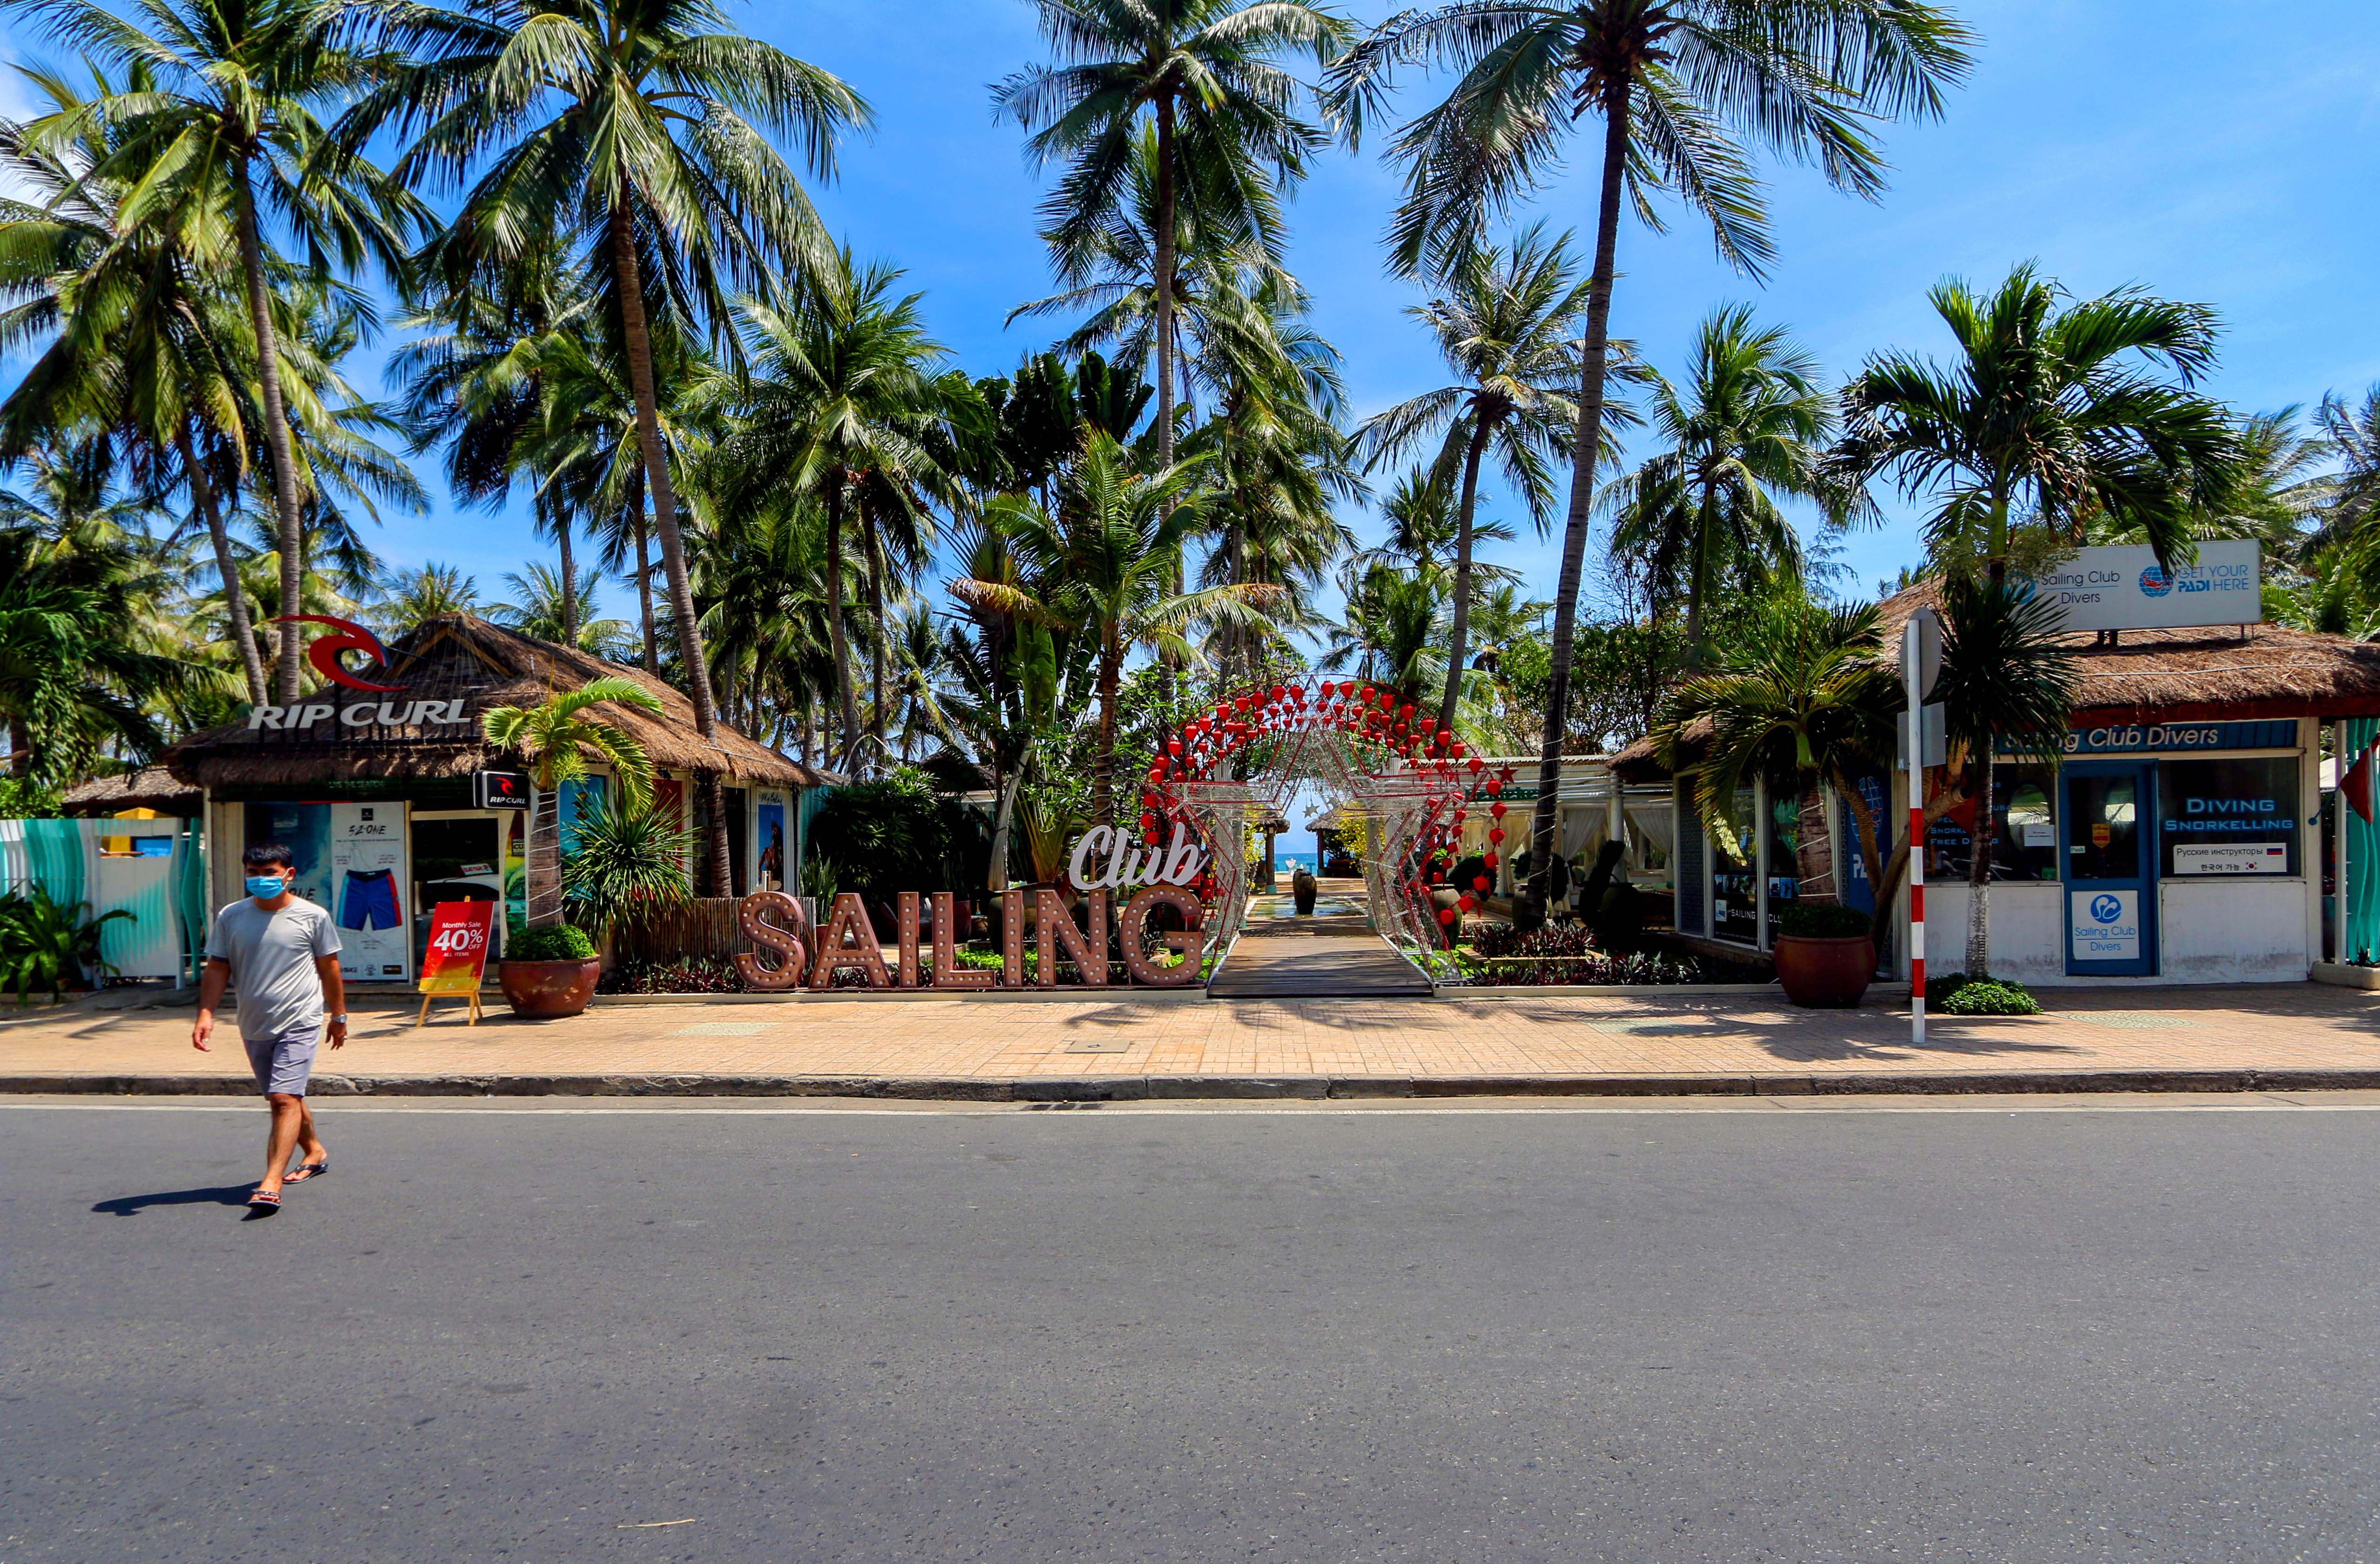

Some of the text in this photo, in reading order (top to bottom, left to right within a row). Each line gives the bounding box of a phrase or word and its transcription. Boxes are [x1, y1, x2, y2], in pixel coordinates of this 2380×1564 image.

[2041, 570, 2120, 586] Sailing Club
[2178, 565, 2248, 579] GET YOUR
[2178, 578, 2249, 593] PADI HERE
[2062, 592, 2100, 605] Divers
[248, 699, 471, 729] RIP CURL
[2088, 728, 2141, 747] Club
[2147, 726, 2218, 746] Divers
[2187, 798, 2275, 812] DIVING
[2165, 820, 2293, 830] SNORKELLING
[1069, 822, 1209, 890] Club
[2177, 848, 2263, 857] Русские инструкторы
[1731, 909, 1756, 920] SAILING
[734, 884, 1202, 988] SAILING
[2075, 926, 2136, 937] Sailing Club
[2090, 941, 2121, 951] Divers
